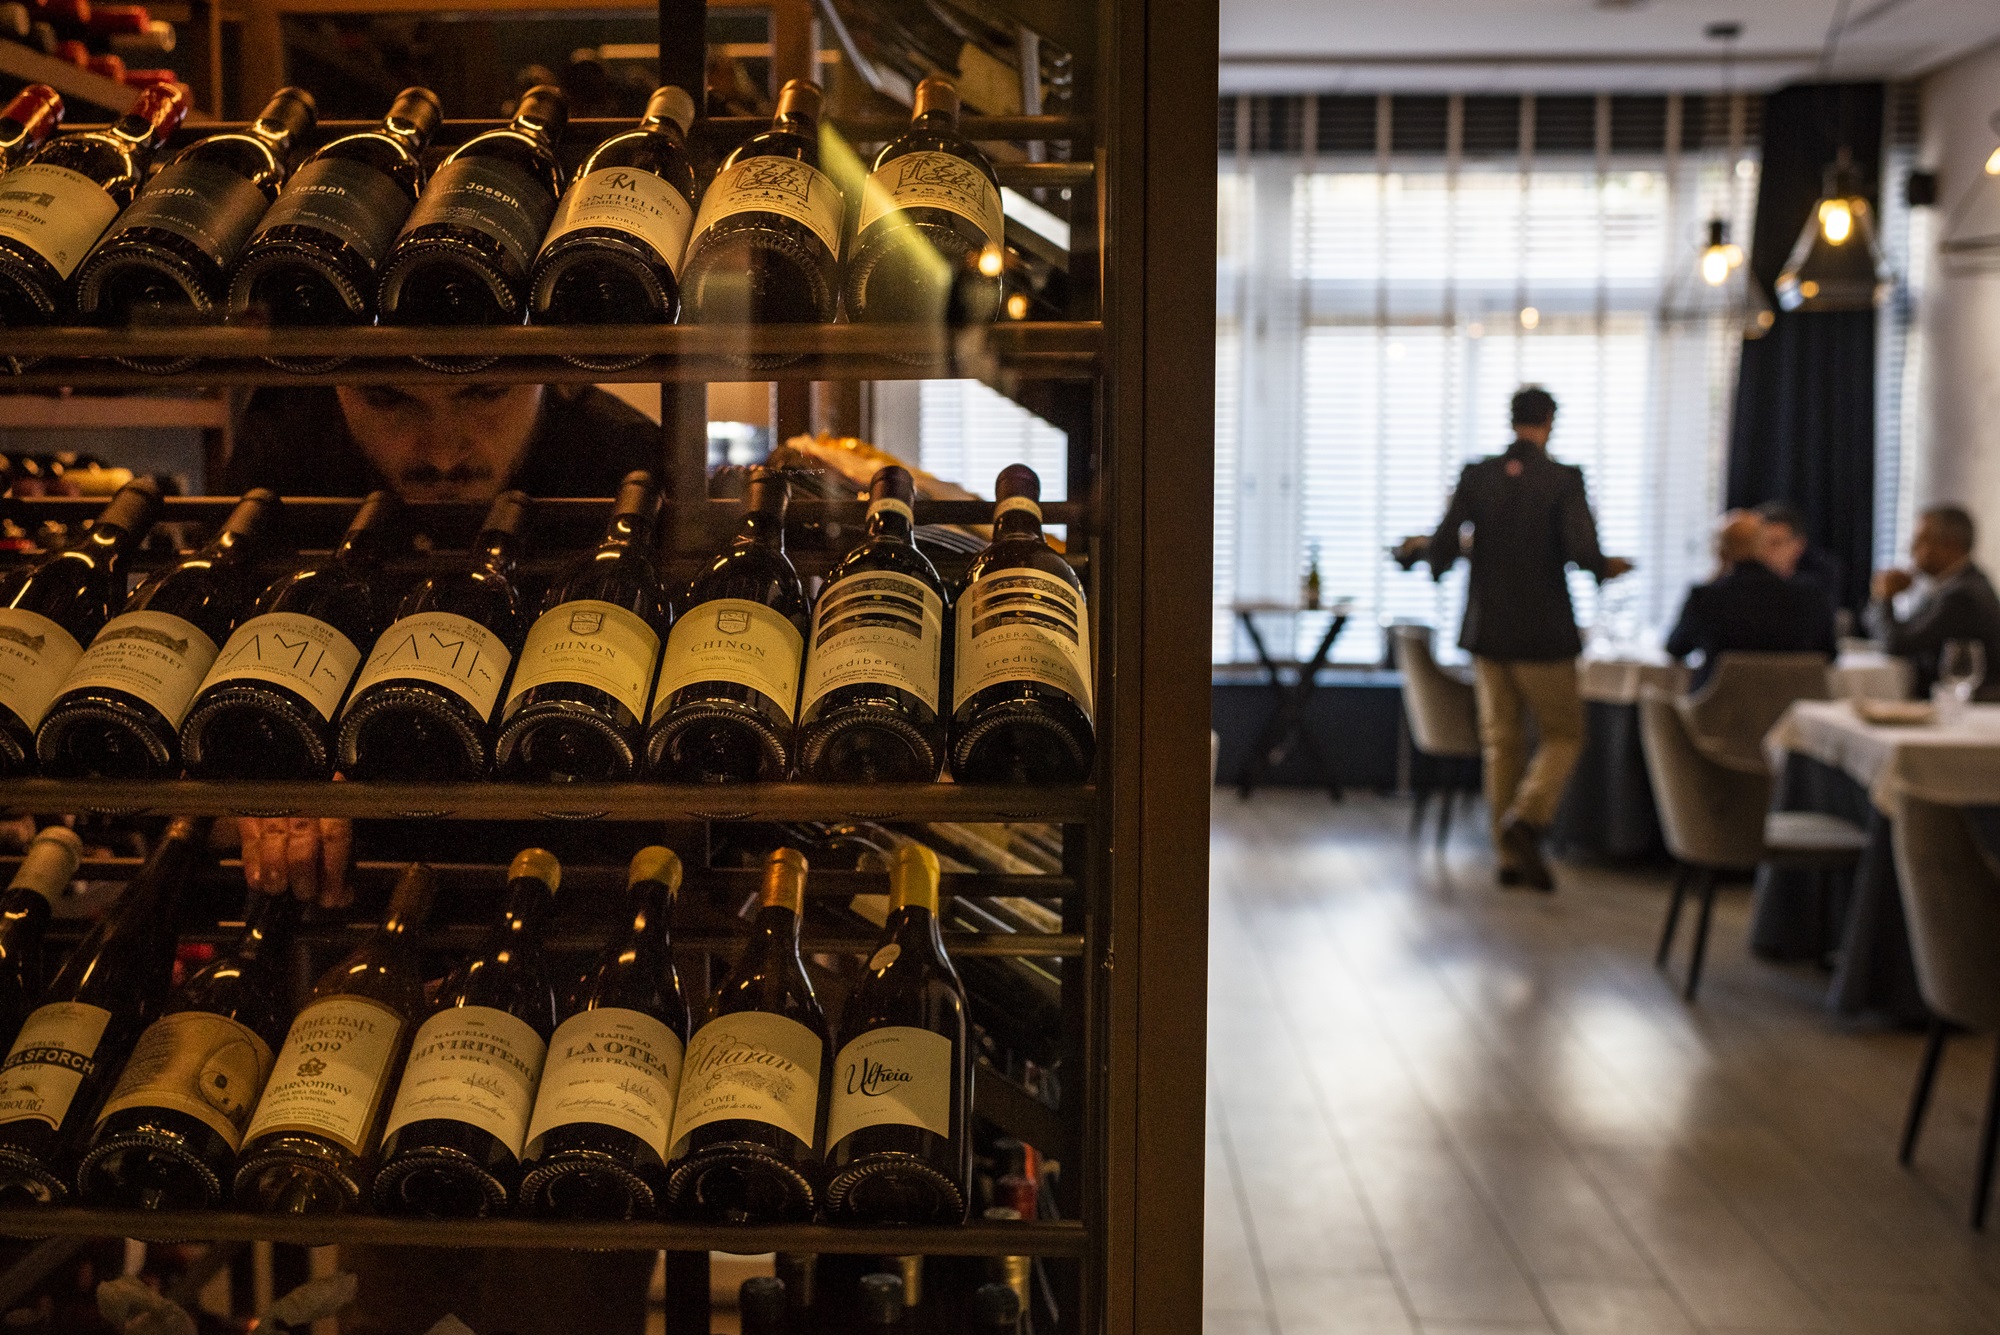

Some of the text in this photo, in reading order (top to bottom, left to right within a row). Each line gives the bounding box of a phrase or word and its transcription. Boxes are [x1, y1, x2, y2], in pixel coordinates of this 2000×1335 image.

[144, 187, 195, 199] Joseph
[291, 185, 346, 197] Joseph
[465, 181, 520, 210] Joseph
[573, 193, 666, 220] ONTHELIE
[578, 199, 622, 210] PREMIER
[624, 202, 647, 214] CRU
[568, 215, 602, 226] PIERRE
[605, 215, 644, 229] MOREY
[542, 640, 617, 659] CHINON
[691, 640, 766, 657] CHINON
[817, 635, 866, 660] BARBERA
[871, 634, 918, 651] D'ALBA
[975, 631, 1030, 650] BARBERA
[1036, 634, 1077, 657] D'ALBA
[128, 650, 150, 661] CRU
[576, 656, 601, 667] Vignes
[727, 655, 752, 666] Vignes
[822, 657, 906, 678] trediberri
[985, 655, 1071, 676] trediberri
[299, 1040, 343, 1055] 2019
[594, 1032, 652, 1050] MAJUELO
[564, 1041, 671, 1079] LA OTEA
[580, 1056, 653, 1077] PIE FRANCO
[844, 1056, 914, 1097] Ultreia
